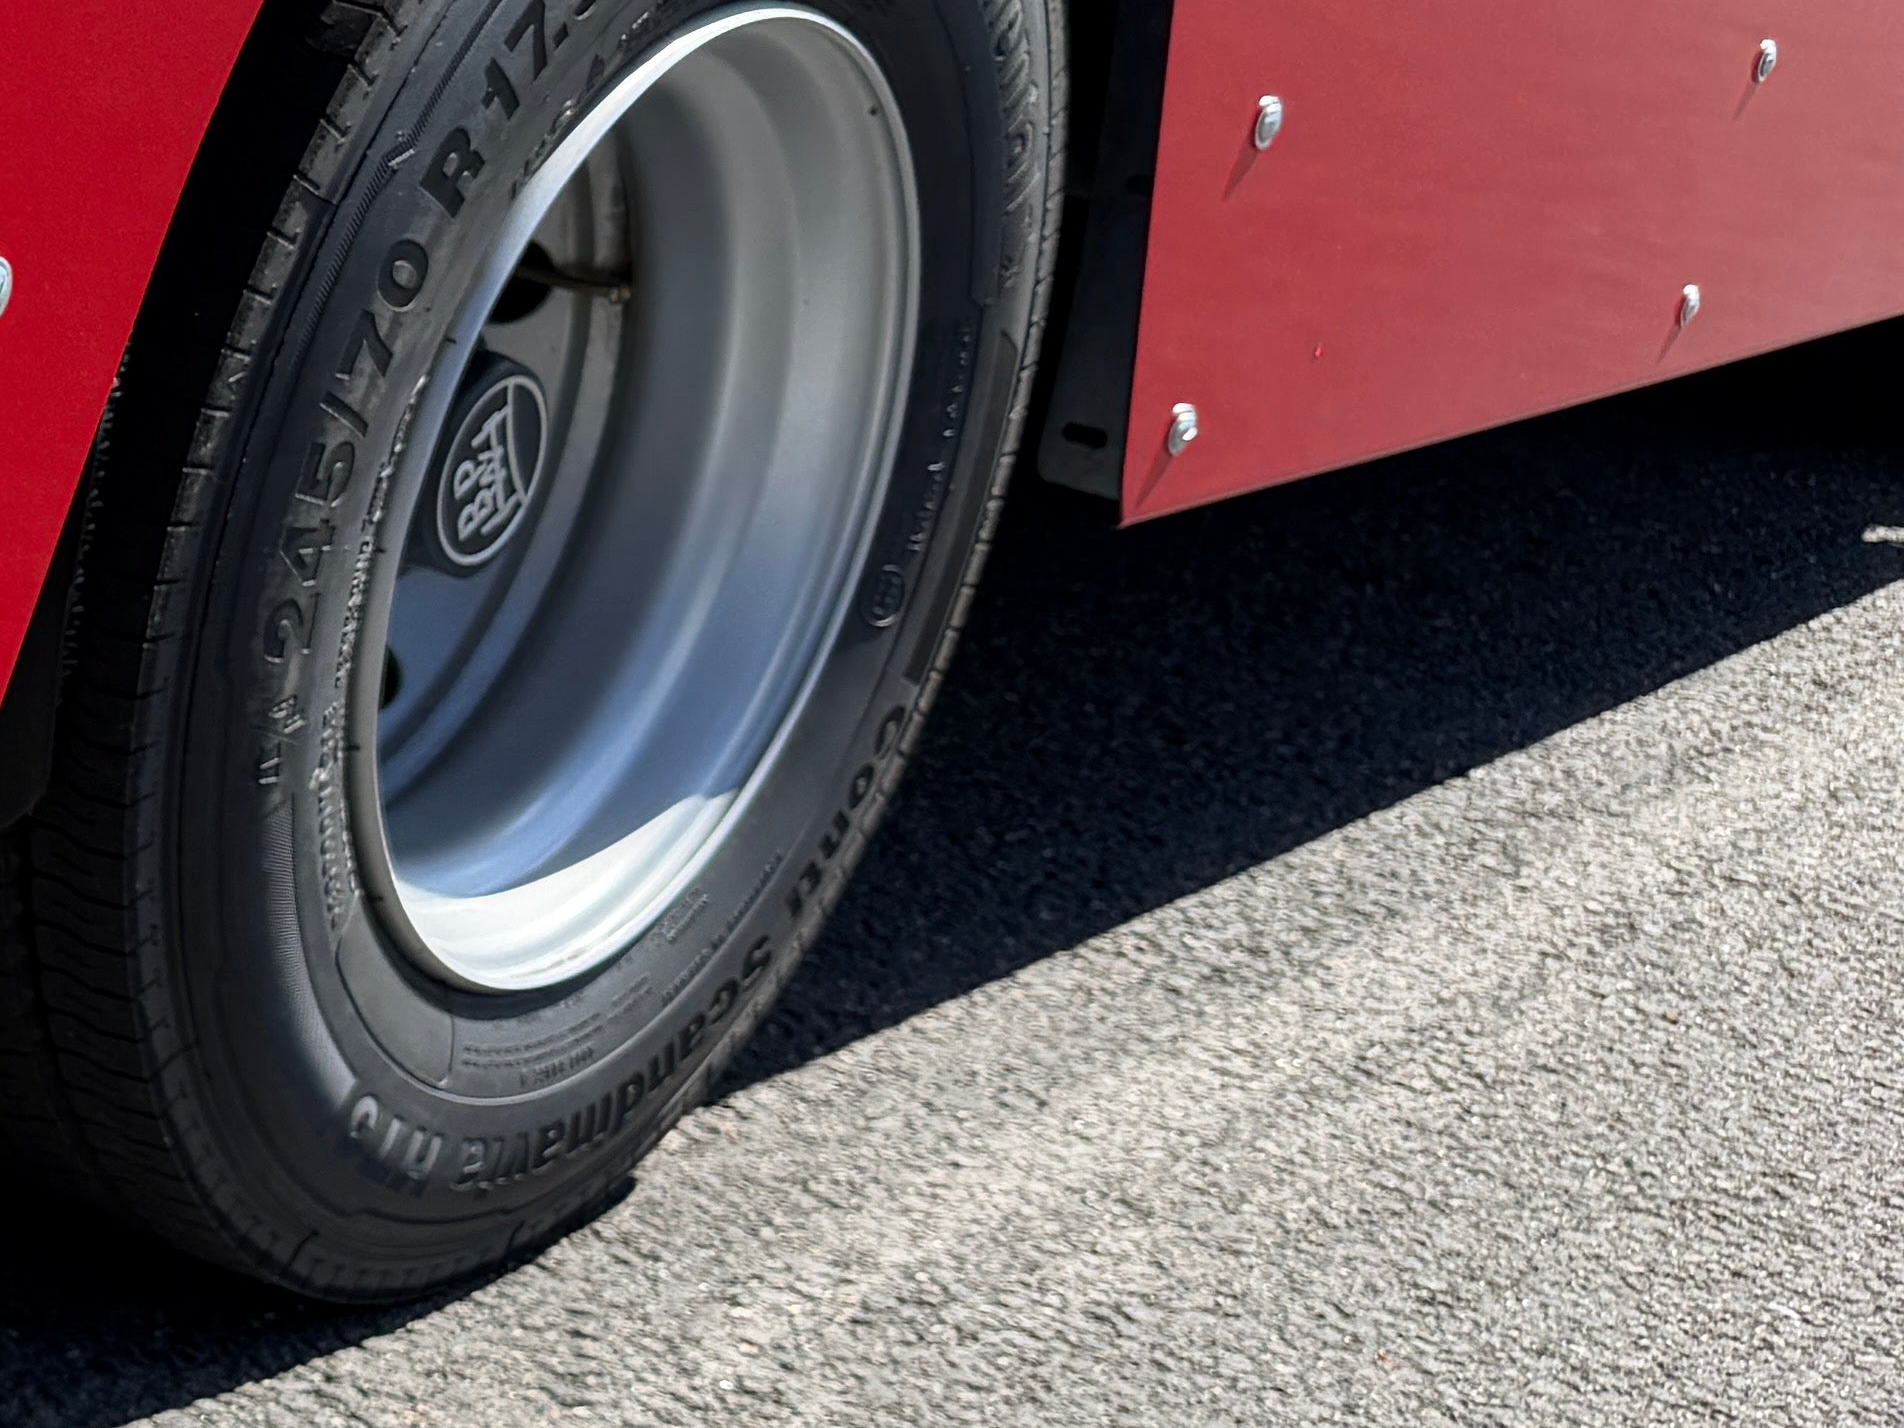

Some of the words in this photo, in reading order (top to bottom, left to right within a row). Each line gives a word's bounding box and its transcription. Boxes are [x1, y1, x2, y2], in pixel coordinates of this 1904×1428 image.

[262, 237, 429, 664] 245/70
[784, 705, 907, 921] Conti
[447, 933, 772, 1193] Scandinavia
